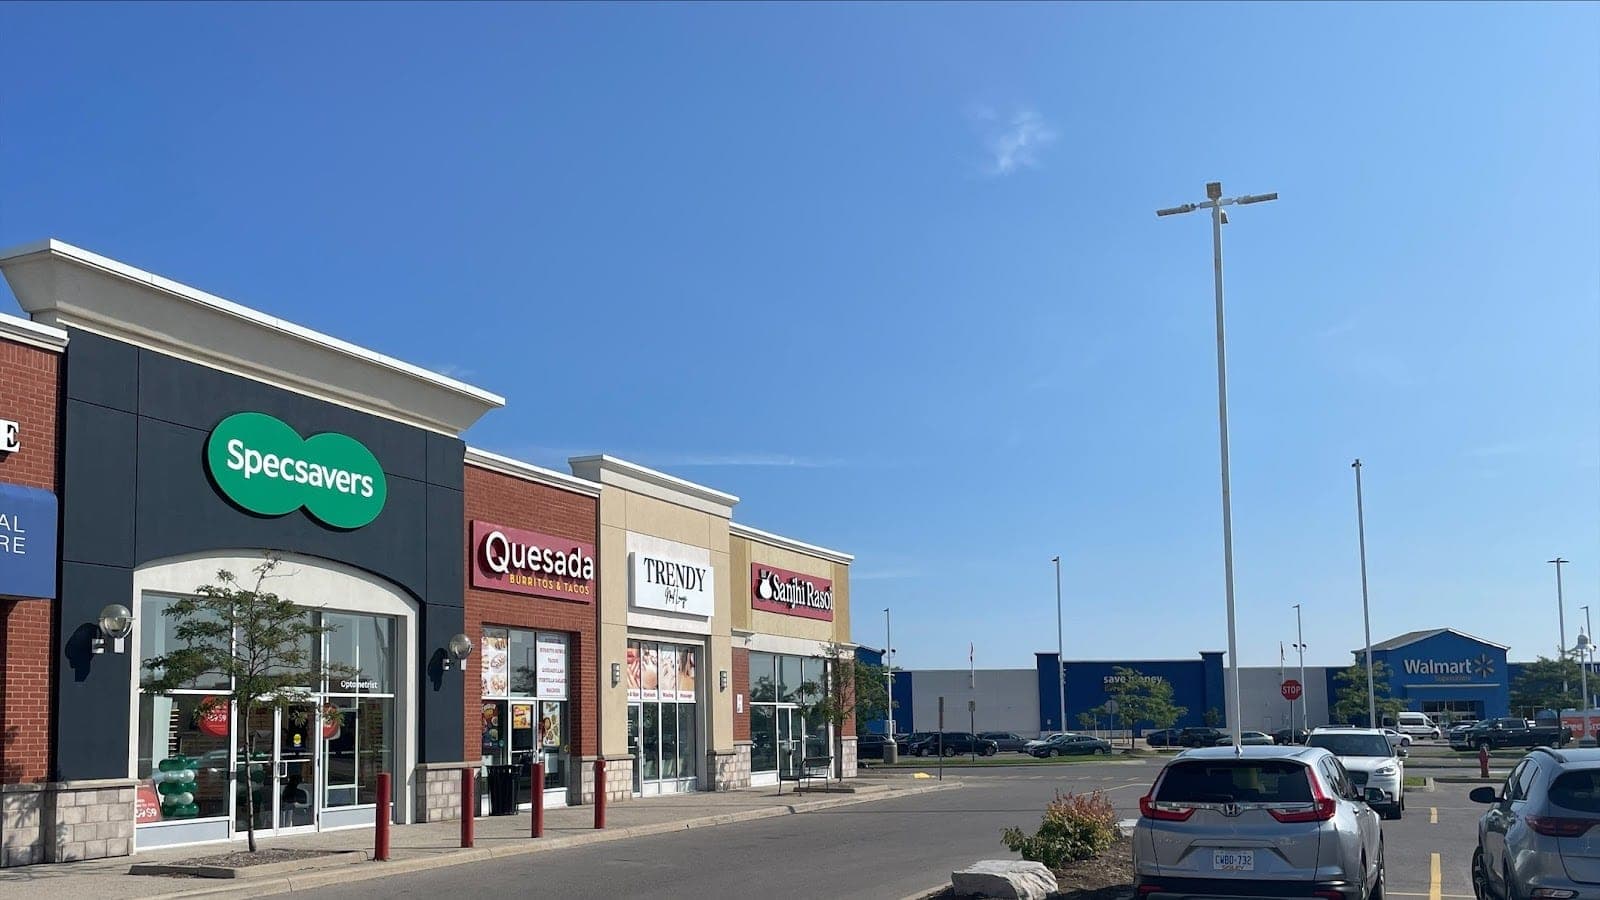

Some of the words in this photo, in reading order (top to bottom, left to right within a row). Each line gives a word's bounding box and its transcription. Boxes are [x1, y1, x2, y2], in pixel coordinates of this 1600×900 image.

[226, 438, 375, 498] Specsavers
[0, 513, 26, 533] AL
[485, 530, 594, 581] Quesada
[509, 573, 554, 591] BURRITOS
[556, 580, 561, 591] &
[563, 582, 590, 595] TACOS
[643, 557, 706, 592] TRENDY
[773, 574, 806, 609] Sanjhi
[806, 581, 833, 610] Rasoi
[1404, 658, 1472, 674] Walmart
[340, 680, 379, 689] Optometrist
[1103, 675, 1126, 684] save
[1282, 685, 1301, 695] STOP
